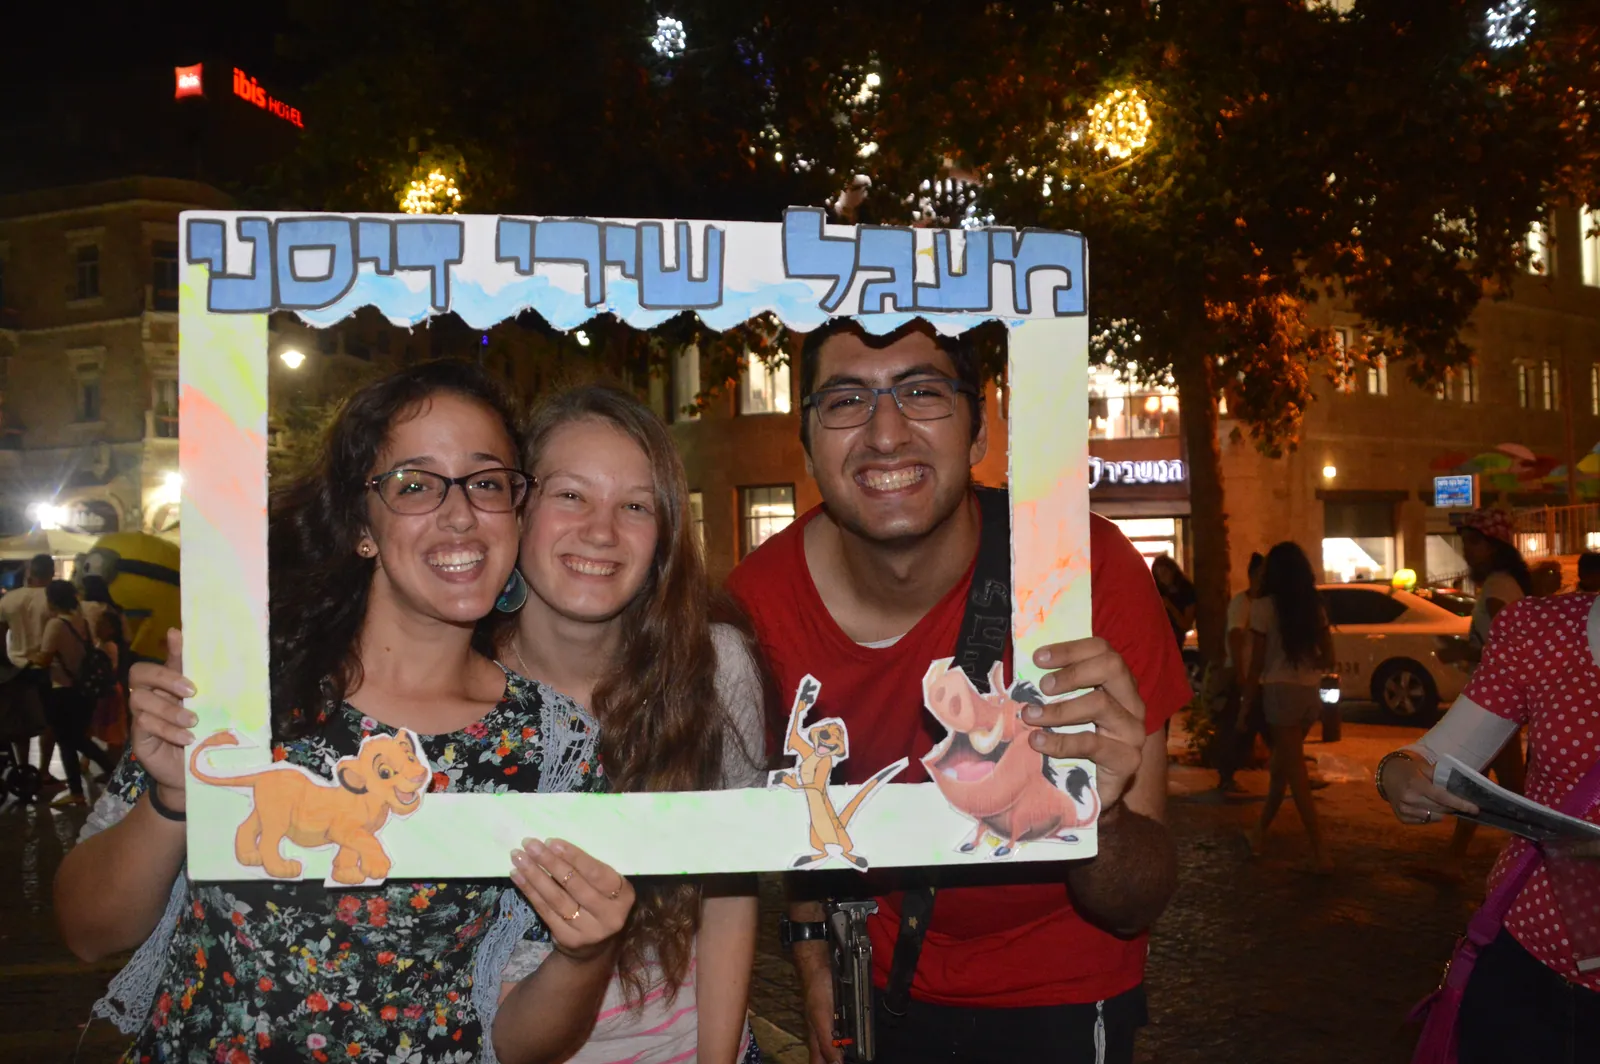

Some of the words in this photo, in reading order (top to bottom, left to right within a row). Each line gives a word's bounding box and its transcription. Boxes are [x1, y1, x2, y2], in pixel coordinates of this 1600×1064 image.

[233, 67, 266, 109] ibis
[268, 96, 304, 128] HOTEL
[186, 215, 465, 314] דיסני
[495, 214, 725, 311] שירי
[782, 206, 1088, 316] מעגל
[1104, 459, 1185, 484] המשביר
